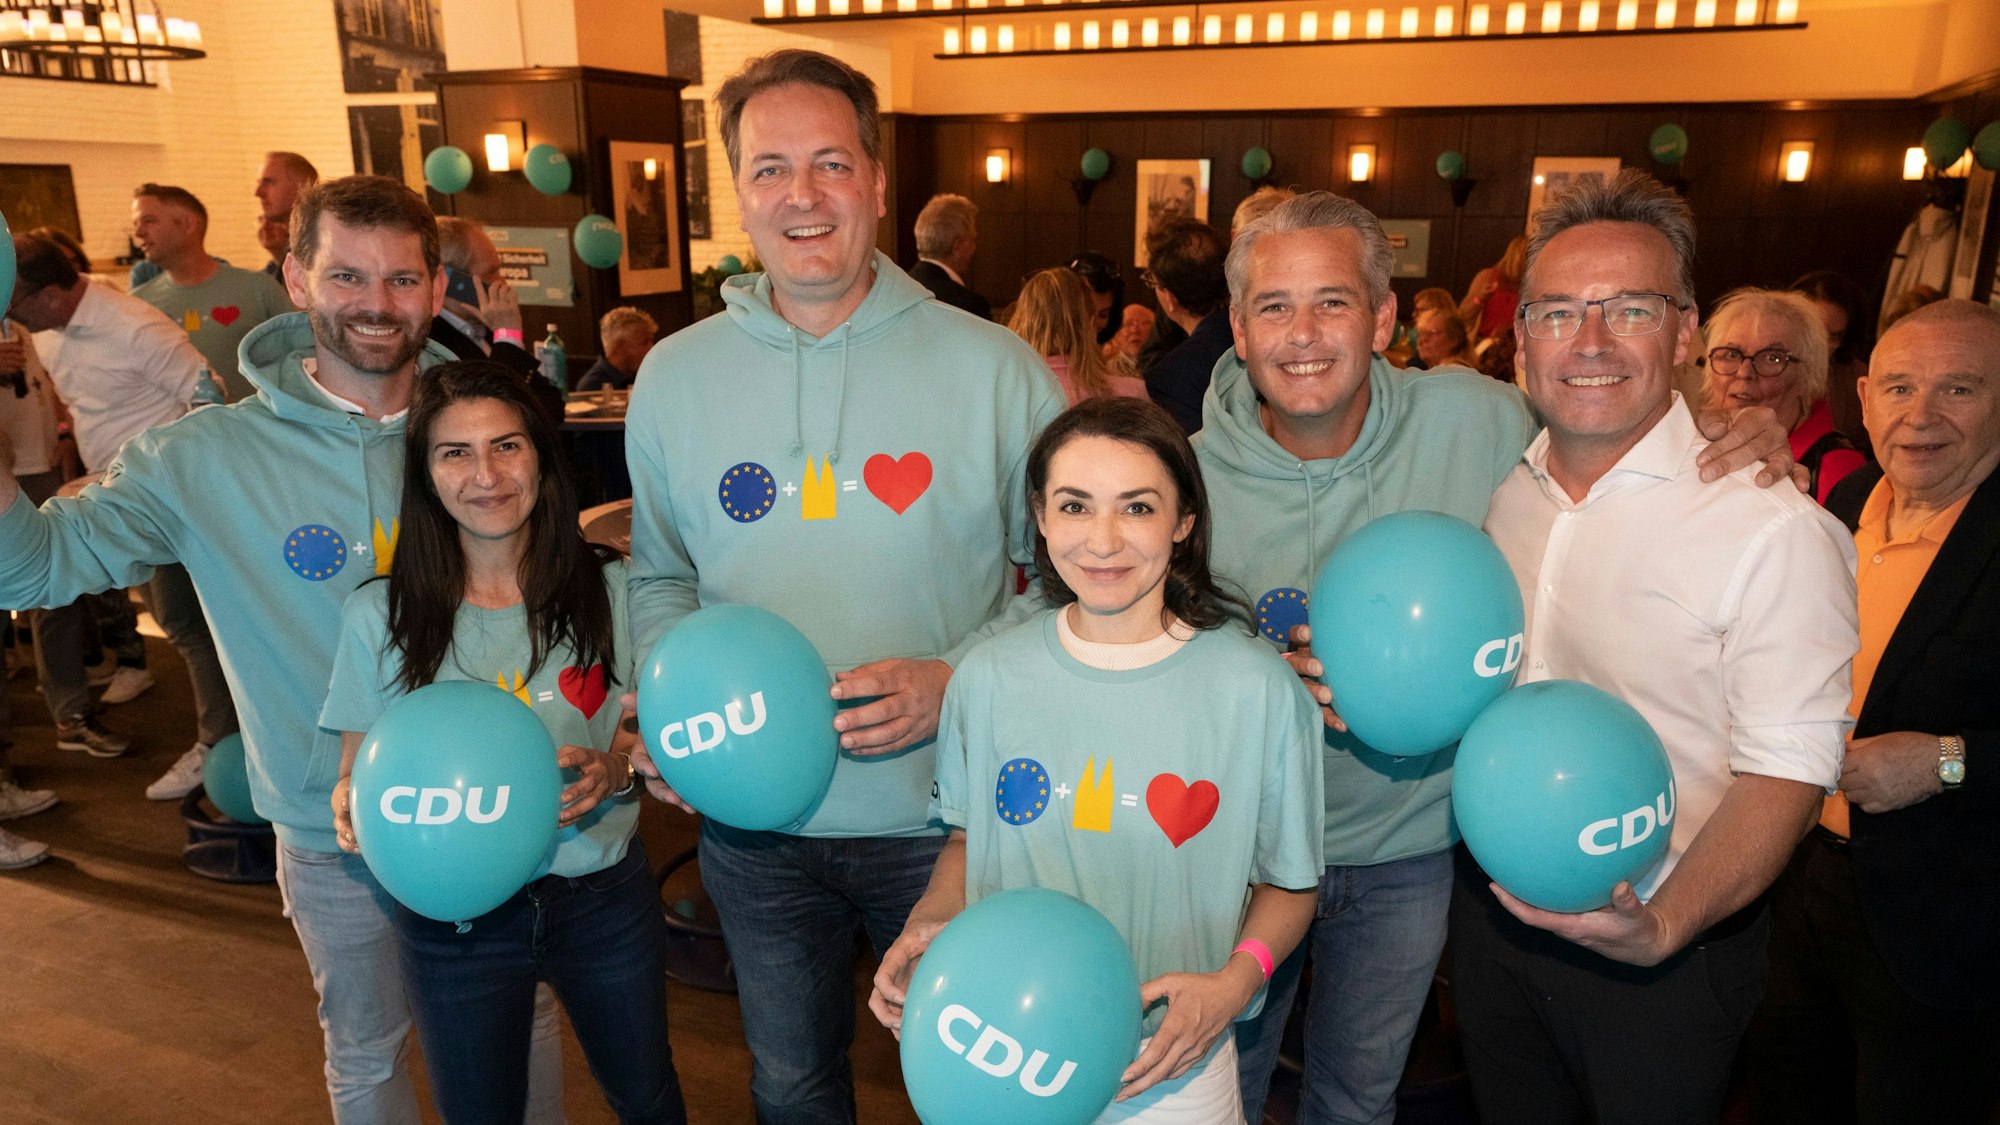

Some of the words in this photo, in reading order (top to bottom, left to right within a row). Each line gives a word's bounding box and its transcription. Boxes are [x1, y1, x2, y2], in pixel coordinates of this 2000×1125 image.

[502, 252, 546, 264] Sicherheit
[1473, 632, 1524, 678] CD
[660, 690, 768, 759] CDU
[379, 784, 511, 825] CDU
[1577, 778, 1676, 856] CDU
[937, 1003, 1077, 1098] CDU
